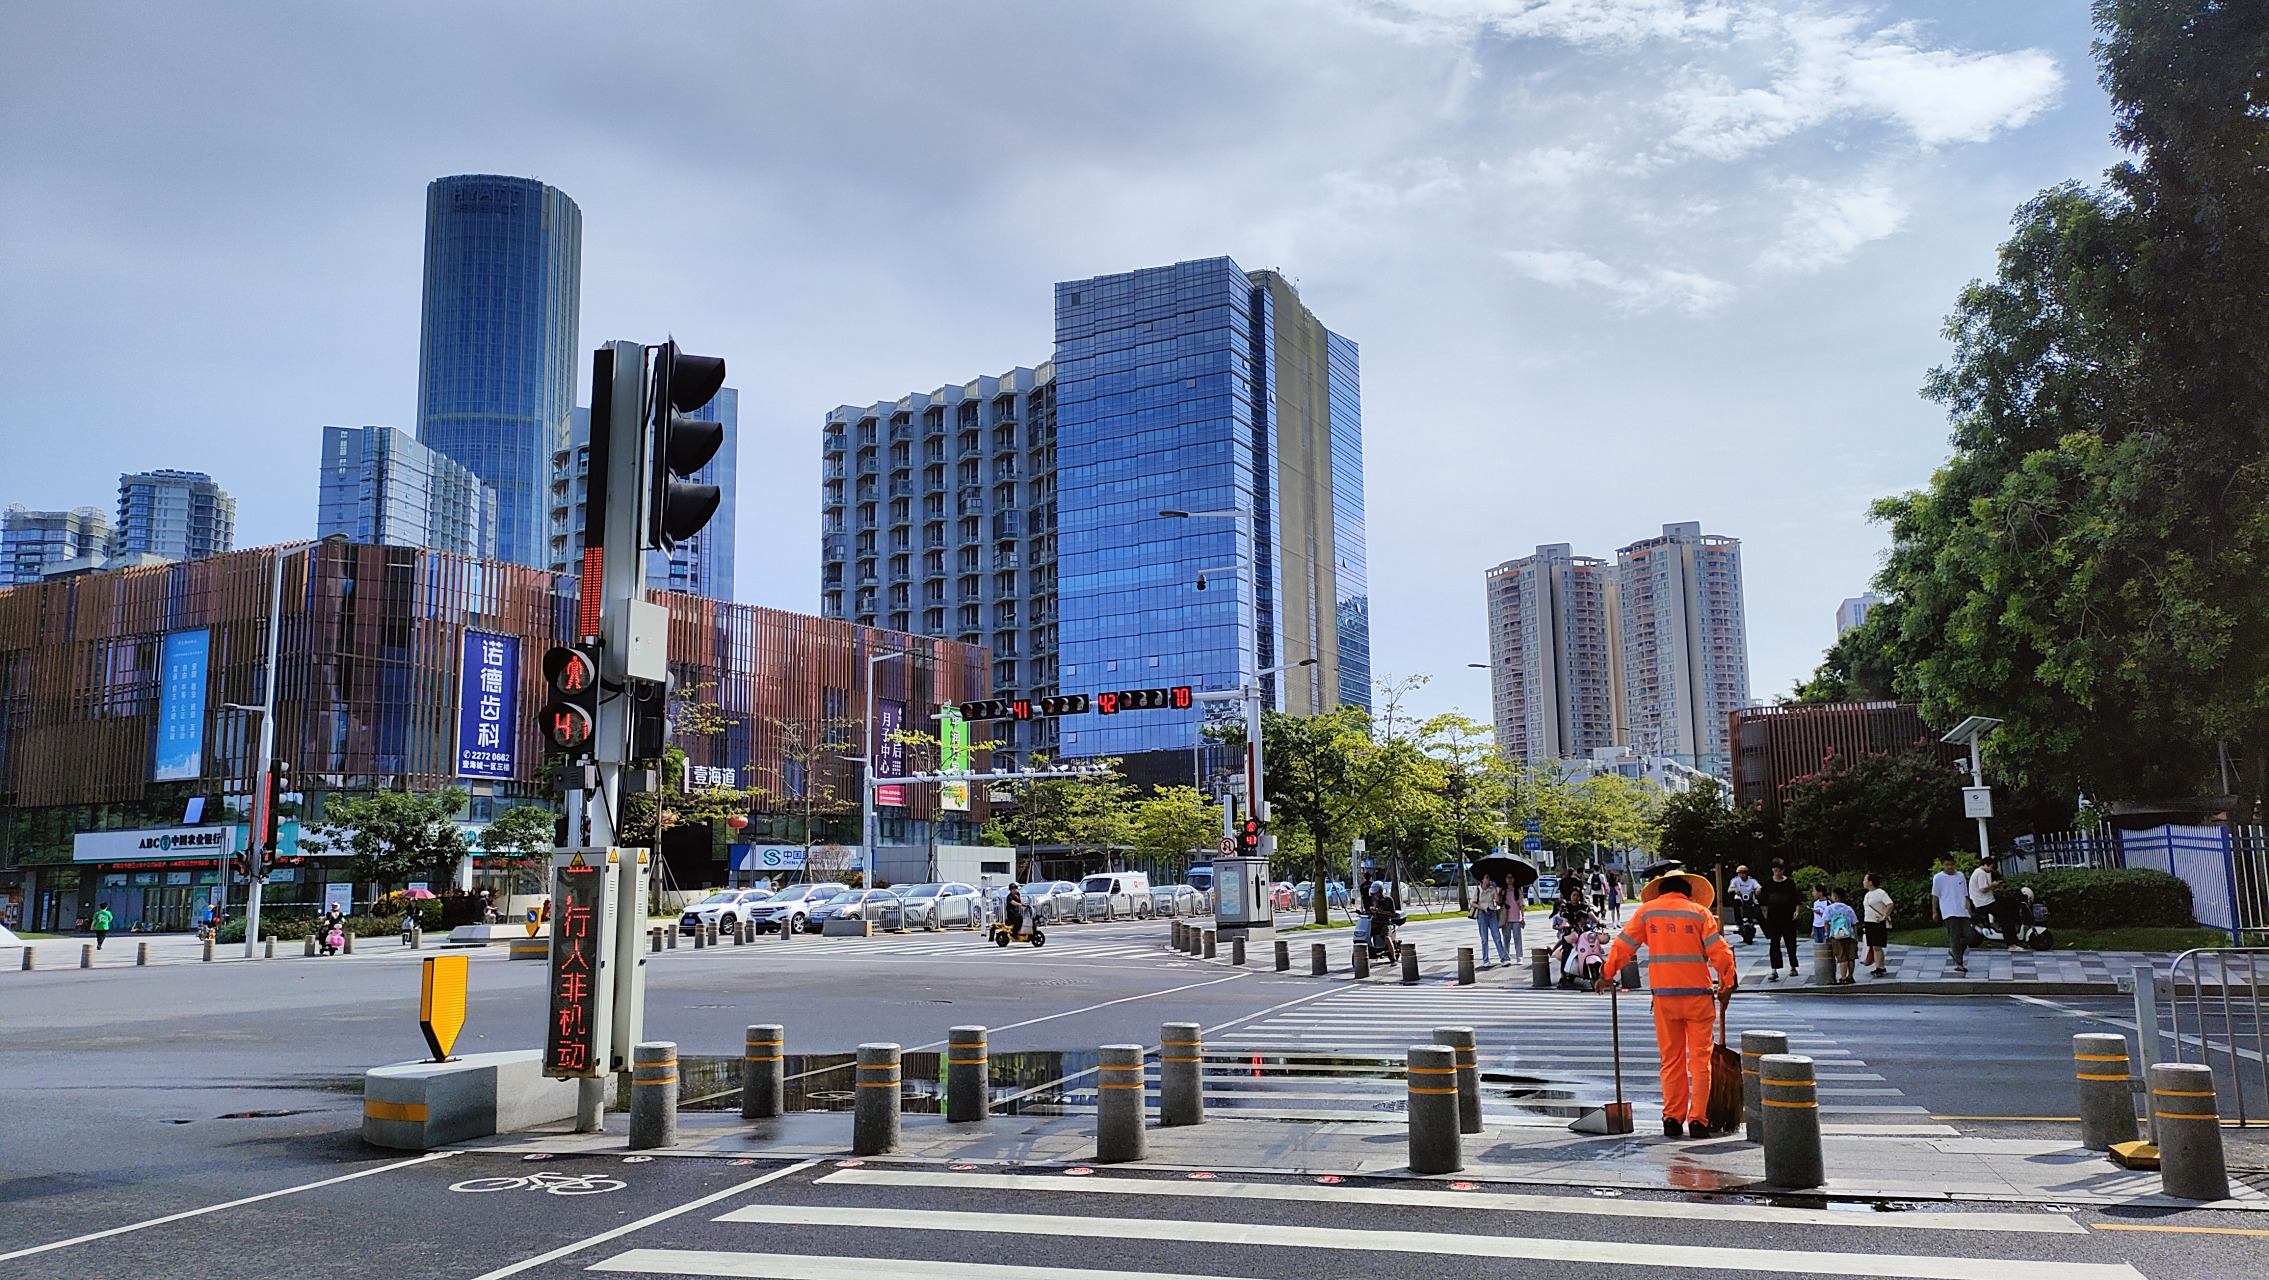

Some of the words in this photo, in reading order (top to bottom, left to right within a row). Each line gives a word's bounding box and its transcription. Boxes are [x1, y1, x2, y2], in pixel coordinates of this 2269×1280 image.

[455, 188, 519, 203] HYATT
[478, 640, 504, 749] 诺德齿科
[1099, 694, 1115, 713] 42
[1173, 688, 1189, 707] 70
[1013, 701, 1028, 719] 41
[555, 713, 588, 740] 41
[880, 712, 891, 774] 月子中心
[471, 751, 490, 761] 2272
[492, 752, 510, 762] 0662
[693, 765, 736, 787] 壹海道
[139, 838, 160, 849] ABC
[171, 833, 221, 847] 中国农业银行
[558, 895, 591, 1068] 行人非机动
